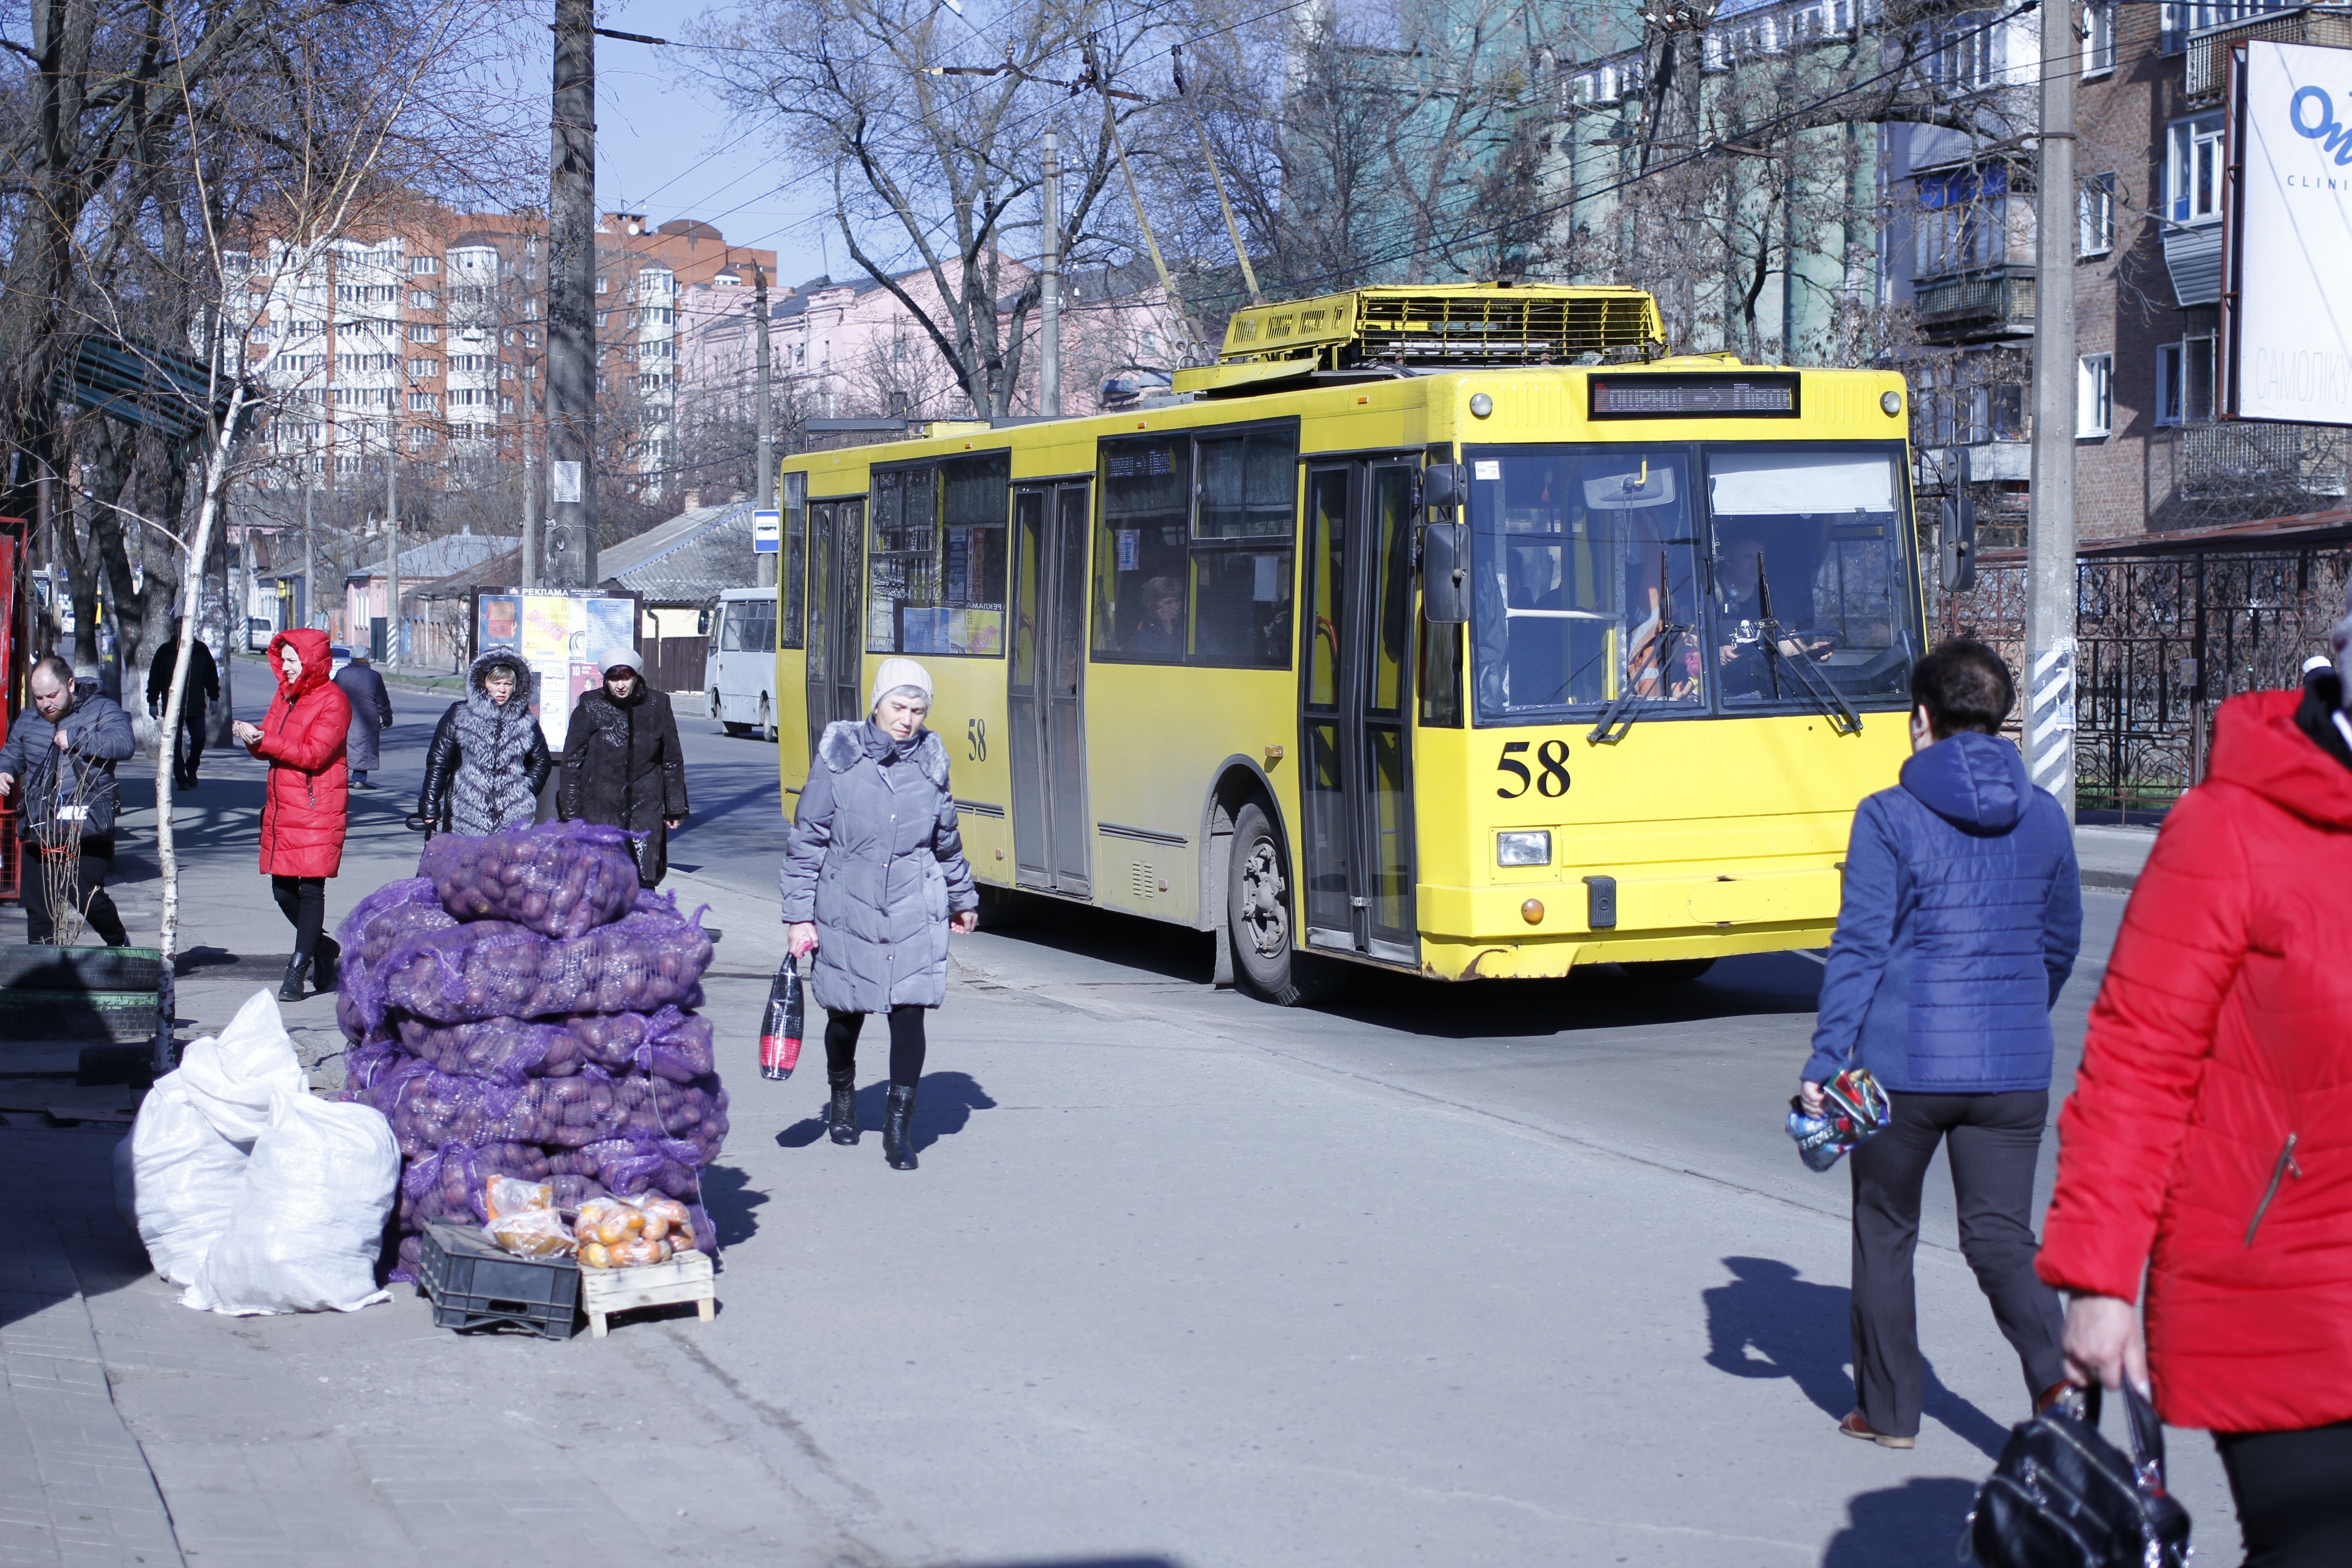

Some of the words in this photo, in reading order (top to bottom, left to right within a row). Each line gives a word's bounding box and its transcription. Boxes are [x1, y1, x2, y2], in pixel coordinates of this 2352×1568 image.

[522, 588, 569, 597] РЕКЛАМА
[572, 666, 580, 676] 10
[968, 718, 986, 762] 58
[1496, 740, 1571, 799] 58
